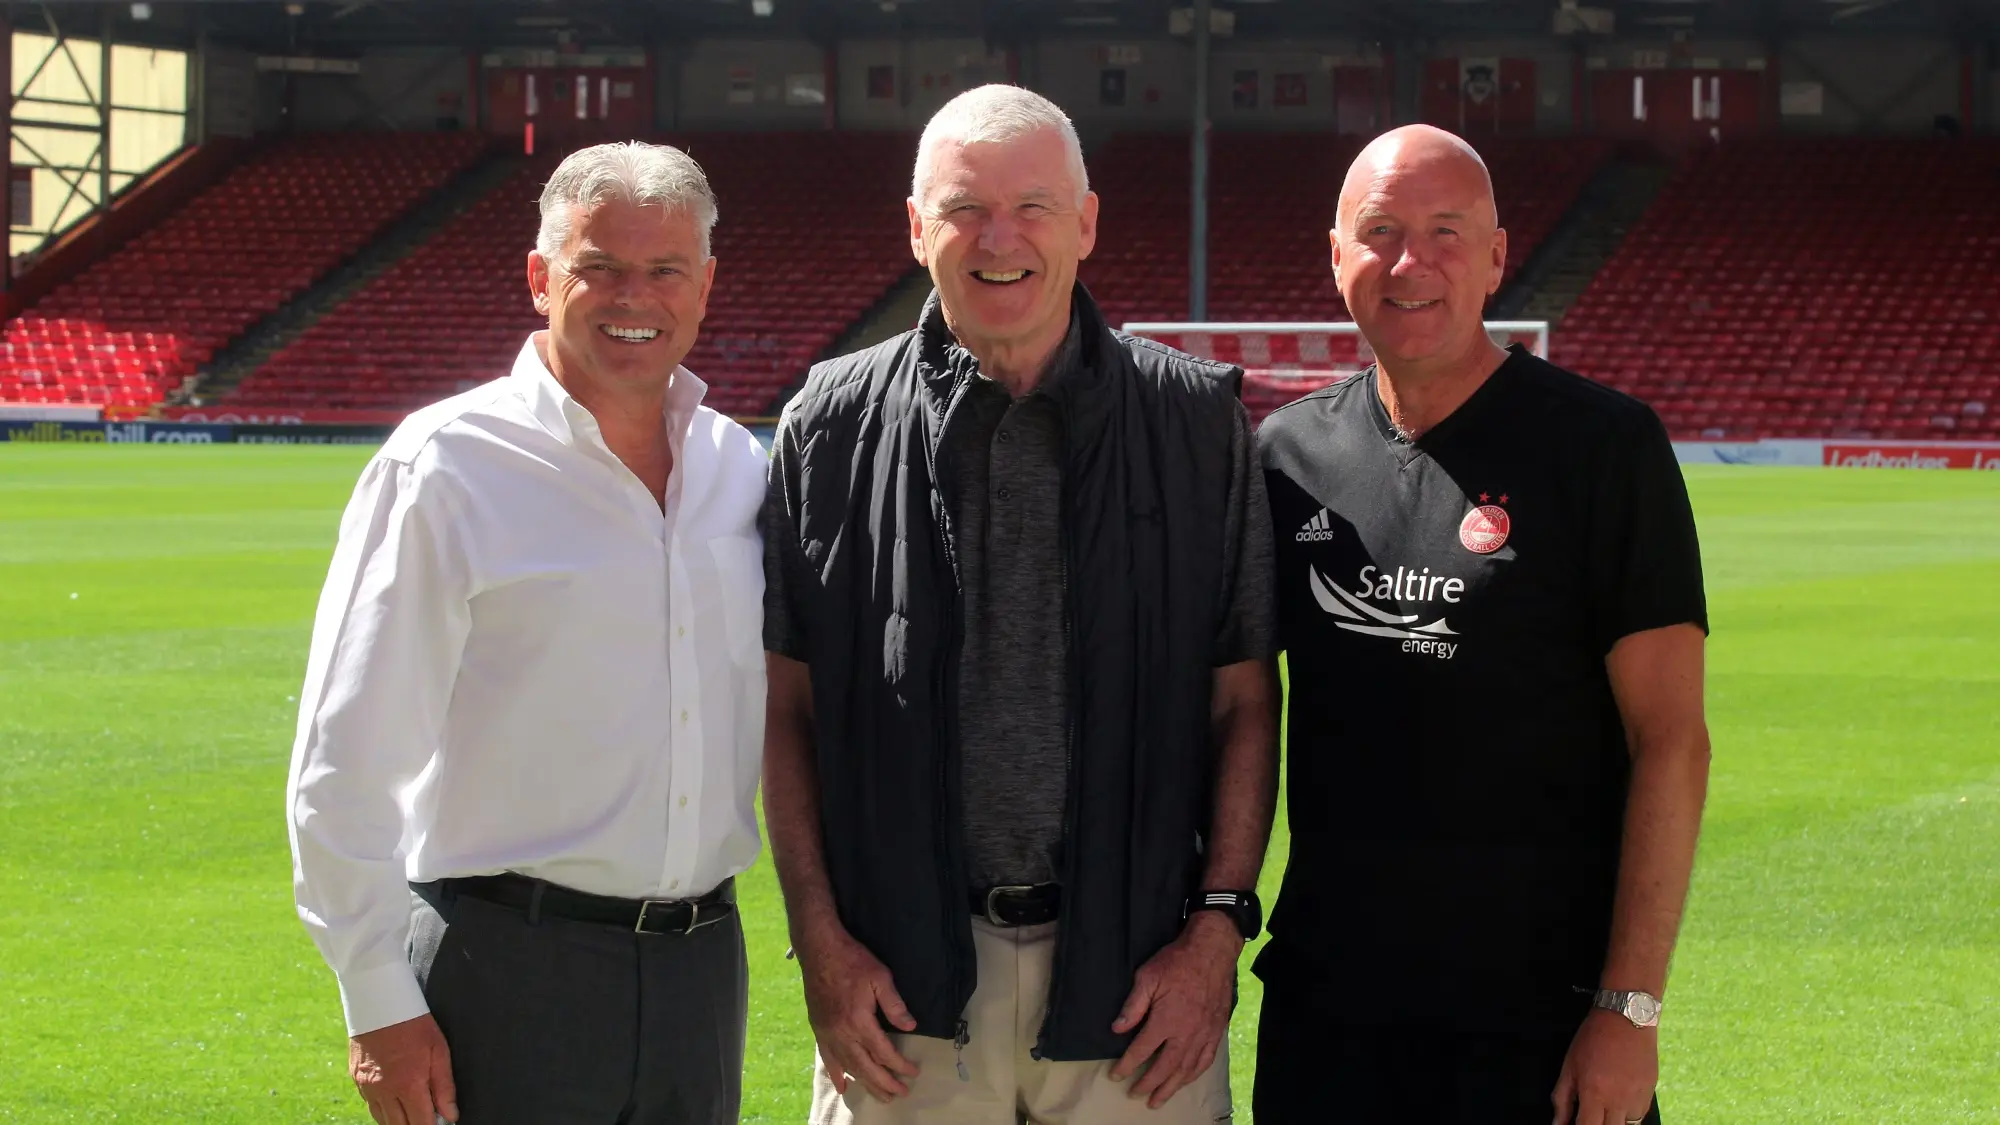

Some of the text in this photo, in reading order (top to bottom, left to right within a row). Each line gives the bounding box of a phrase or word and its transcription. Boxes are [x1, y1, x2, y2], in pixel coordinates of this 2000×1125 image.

[1831, 449, 1949, 469] Ladbrokes
[1295, 529, 1334, 542] adidas
[1355, 565, 1465, 603] Saltire
[1401, 638, 1458, 659] energy
